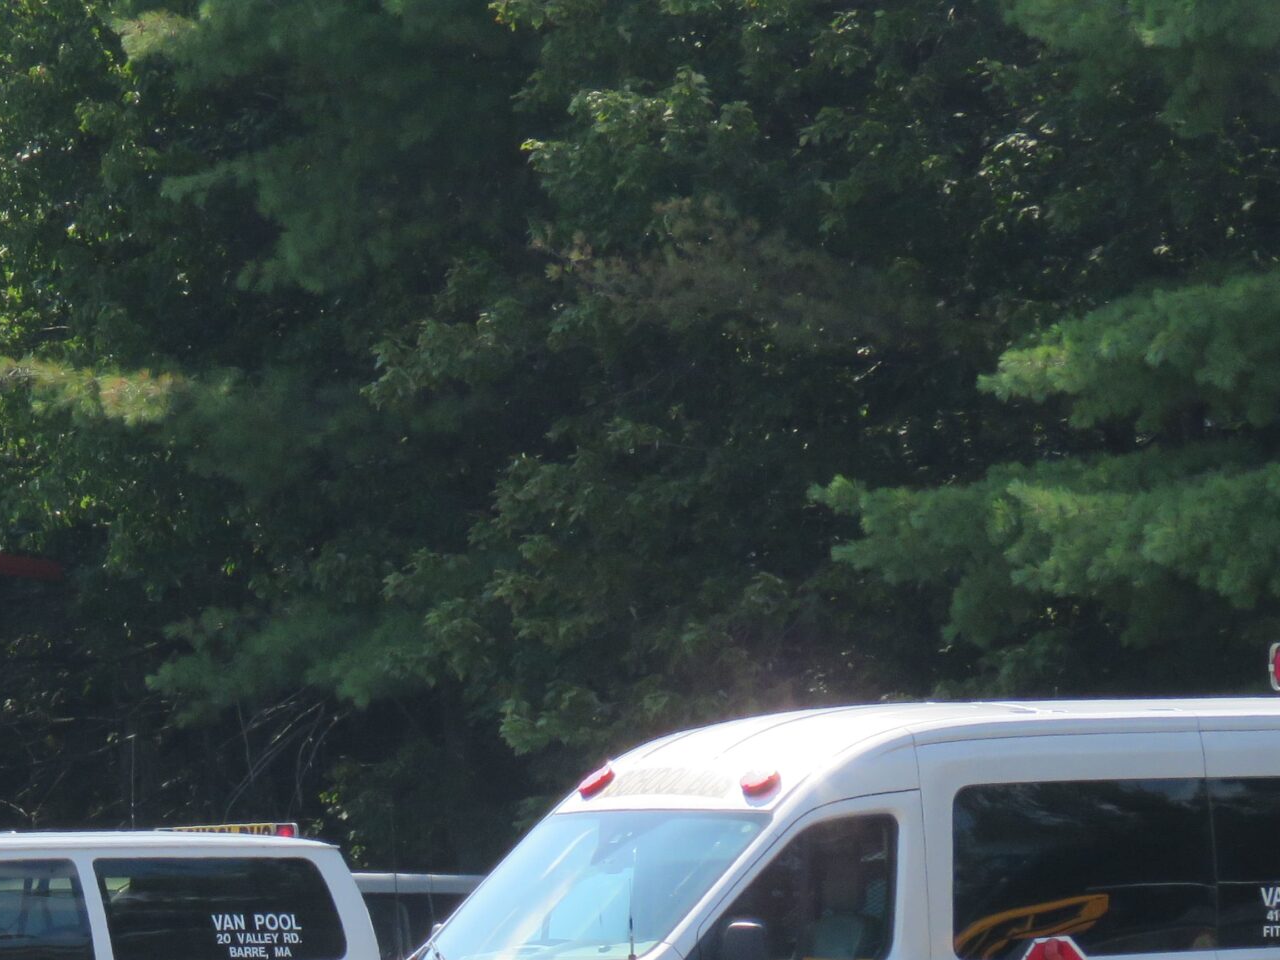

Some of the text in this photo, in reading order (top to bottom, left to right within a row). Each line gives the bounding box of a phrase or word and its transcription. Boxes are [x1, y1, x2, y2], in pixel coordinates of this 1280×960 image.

[211, 913, 302, 931] VAN POOL
[216, 933, 303, 944] 20 VALLEY RD.
[229, 946, 292, 960] BARRE, MA
